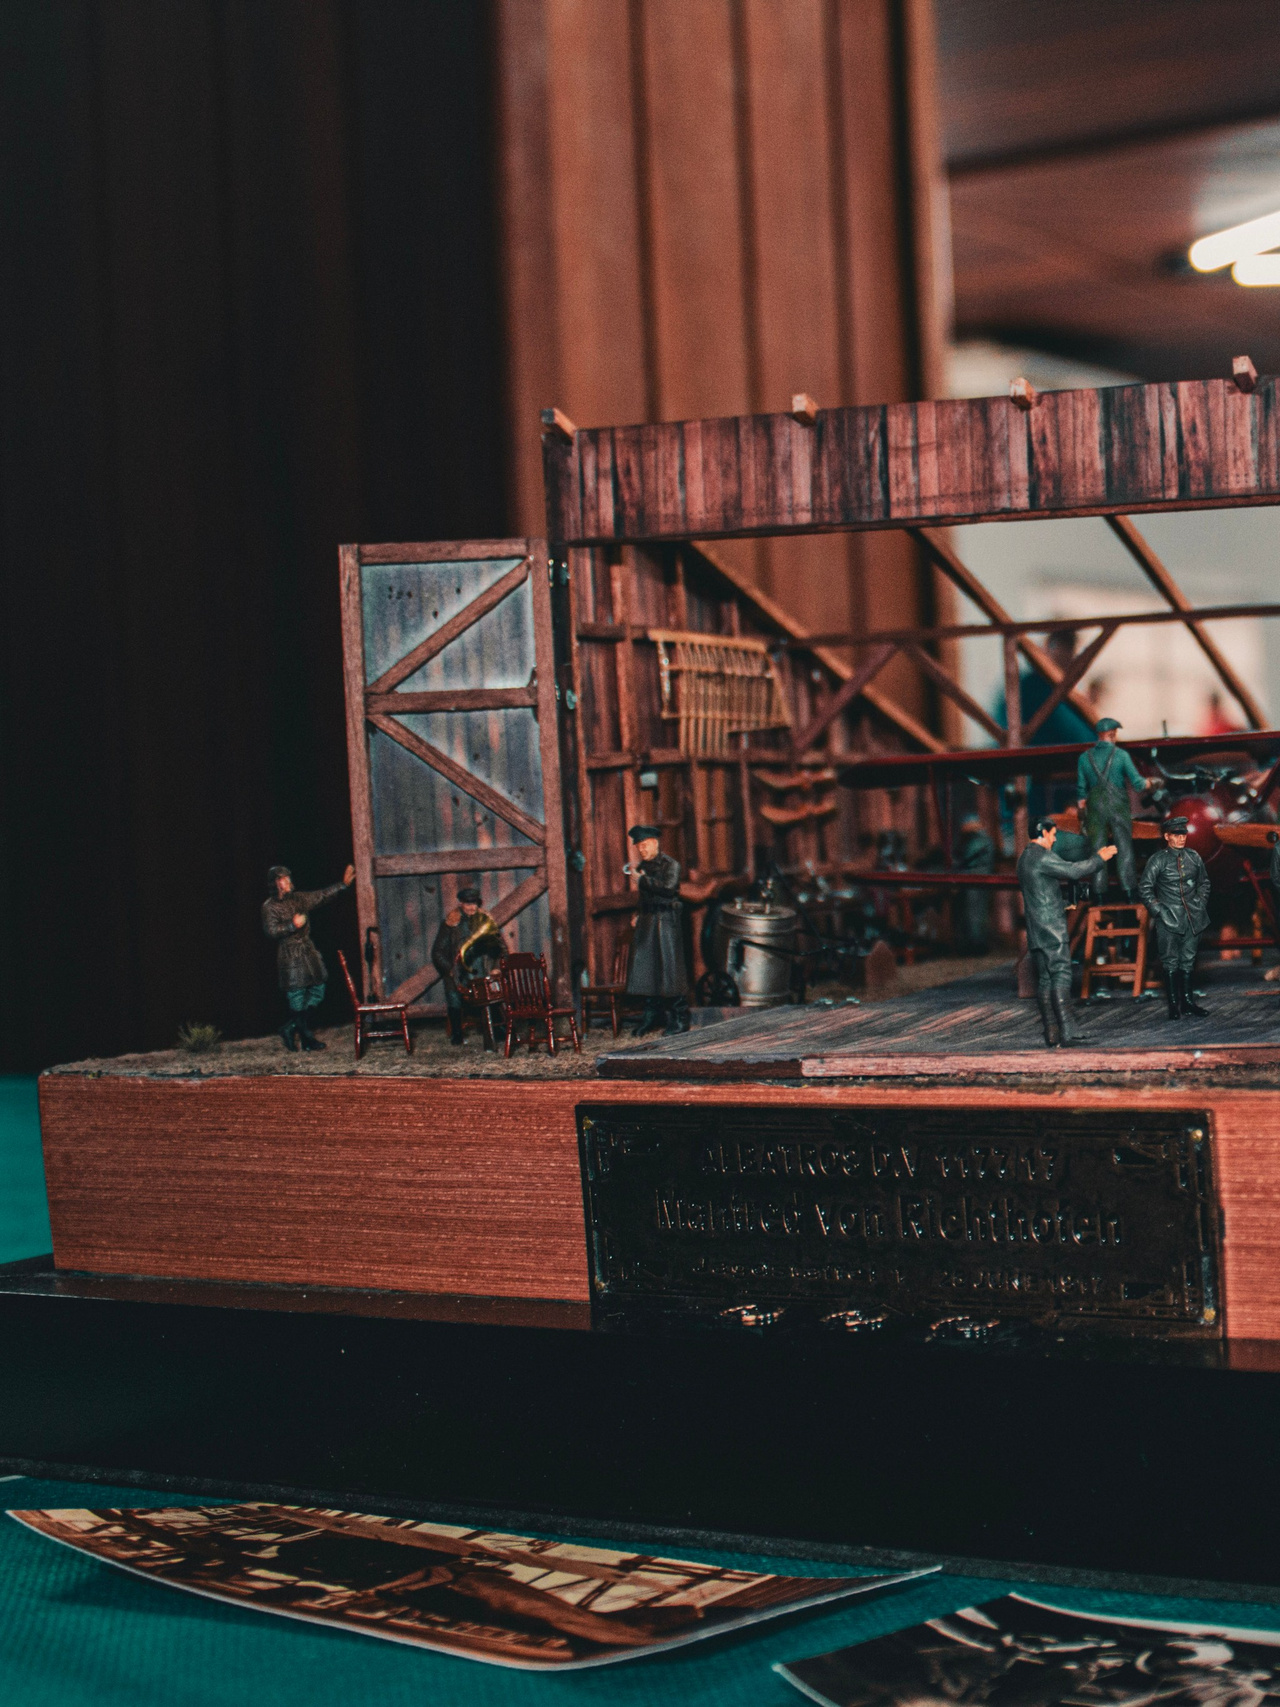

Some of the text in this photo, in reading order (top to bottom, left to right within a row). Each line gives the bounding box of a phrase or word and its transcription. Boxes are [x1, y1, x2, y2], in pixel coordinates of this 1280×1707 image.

[702, 1143, 864, 1177] ALBATROS
[655, 1187, 1127, 1247] Manfred von Richthofen
